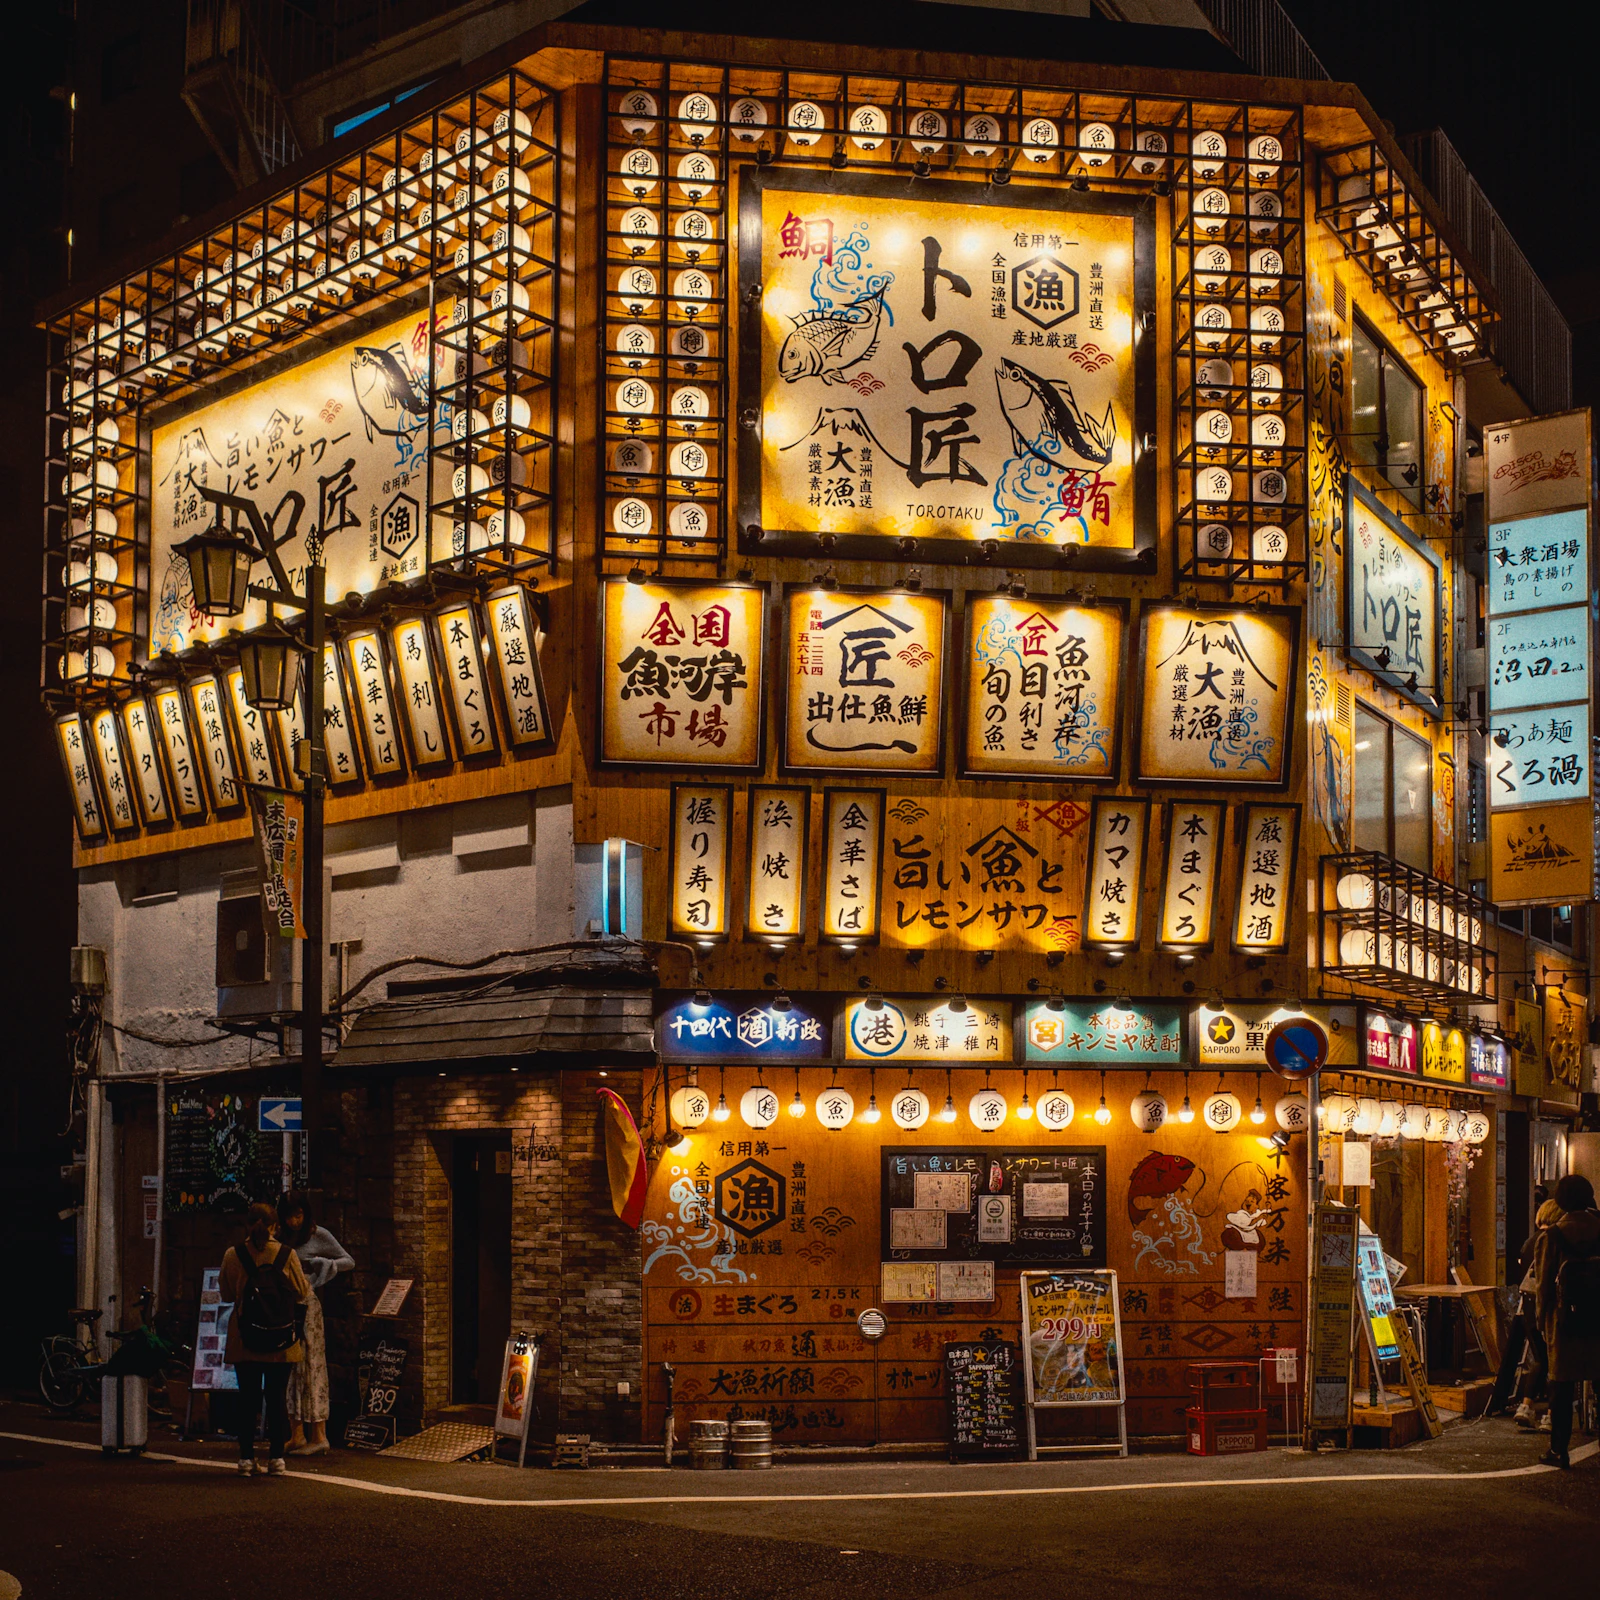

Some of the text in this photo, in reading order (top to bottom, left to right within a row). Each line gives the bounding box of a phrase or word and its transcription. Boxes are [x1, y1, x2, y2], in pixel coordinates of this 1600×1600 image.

[778, 210, 834, 267] 鯛
[1013, 232, 1080, 250] 信用第一
[991, 252, 1007, 320] 全国漁連
[1023, 268, 1066, 311] 漁
[1089, 262, 1104, 331] 豊洲直送
[1011, 330, 1079, 349] 産地厳選
[902, 236, 989, 488] トロ匠
[679, 394, 696, 414] 魚
[1265, 423, 1280, 440] 魚
[1493, 433, 1510, 444] 4F
[227, 431, 351, 494] レモンサワー
[807, 443, 822, 508] 厳選素材
[823, 441, 856, 509] 大漁
[859, 447, 874, 509] 豊洲直送
[1493, 451, 1543, 479] DISCO
[1511, 460, 1552, 481] DEVIL
[180, 462, 198, 524] 大漁
[381, 474, 420, 495] 信用第一
[1059, 468, 1117, 527] 鮪
[1213, 477, 1227, 495] 魚
[387, 507, 411, 545] 漁
[906, 503, 984, 521] TOROTAKU
[368, 504, 378, 562] 全国漁連
[1267, 535, 1282, 553] 魚
[1495, 529, 1511, 542] 3F
[380, 555, 419, 581] 産地厳選
[1494, 539, 1581, 568] 大衆酒場
[641, 601, 731, 648] 全国
[1363, 563, 1425, 673] トロ匠
[1497, 623, 1511, 635] 2F
[839, 627, 896, 688] 匠
[1022, 624, 1049, 657] 匠
[449, 619, 486, 746] 本まぐろ
[500, 605, 539, 735] 厳選地酒
[617, 645, 747, 705] 魚河岸
[1494, 656, 1585, 686] 沼田 2nd
[360, 646, 395, 764] 金華さば
[405, 634, 438, 752] 馬刺し
[981, 663, 1012, 752] 旬の魚
[1018, 662, 1049, 751] 目利き
[1051, 634, 1091, 746] 魚河岸
[1169, 663, 1190, 742] 厳選素材
[1188, 661, 1227, 742] 大漁
[1224, 667, 1246, 742] 豊洲直送
[639, 701, 729, 748] 市場
[131, 710, 161, 814] 牛タン
[164, 700, 197, 807] 鮭ハラミ
[200, 689, 235, 801] 霜降り肉
[67, 728, 98, 824] 海鮮丼
[99, 719, 131, 821] かに味噌
[1496, 753, 1584, 793] くろ渦
[1056, 805, 1077, 826] 漁
[685, 797, 717, 927] 握り寿司
[762, 800, 793, 928] 浜焼き
[839, 802, 869, 929] 金華さば
[1101, 813, 1130, 934] カマ焼き
[1178, 814, 1208, 938] 本まぐろ
[1247, 817, 1282, 941] 厳選地酒
[1502, 858, 1581, 873] エピタフカレー
[896, 900, 1077, 931] レモンサワー
[669, 1016, 732, 1039] 十四代
[741, 1014, 769, 1040] 酒
[776, 1018, 822, 1041] 新政
[861, 1014, 895, 1046] 港
[913, 1012, 1001, 1030] 銚子 三崎
[1088, 1012, 1154, 1032] 本格品質
[913, 1034, 999, 1051] 焼津 稚内
[1067, 1032, 1181, 1053] キンミヤ焼酎
[1202, 1045, 1241, 1054] SAPPORO
[690, 1100, 705, 1118] 魚
[828, 1101, 844, 1120] 魚
[984, 1105, 1000, 1122] 魚
[1147, 1104, 1162, 1122] 魚
[1286, 1107, 1303, 1125] 魚
[1470, 1124, 1486, 1138] 魚
[719, 1141, 787, 1157] 信用第一
[694, 1161, 711, 1230] 全国漁連
[729, 1174, 775, 1221] 漁
[791, 1161, 807, 1233] 豊洲直送
[1079, 1162, 1098, 1245] 本日のおすすめ
[715, 1240, 784, 1255] 産地厳選
[713, 1293, 798, 1316] 生まぐろ
[1035, 1279, 1105, 1297] ハッピーアワー
[1123, 1289, 1148, 1313] 鮪
[1268, 1286, 1293, 1312] 鮭
[743, 1339, 785, 1353] 秋刀魚
[1041, 1317, 1102, 1341] 299円
[708, 1366, 815, 1396] 大漁祈願
